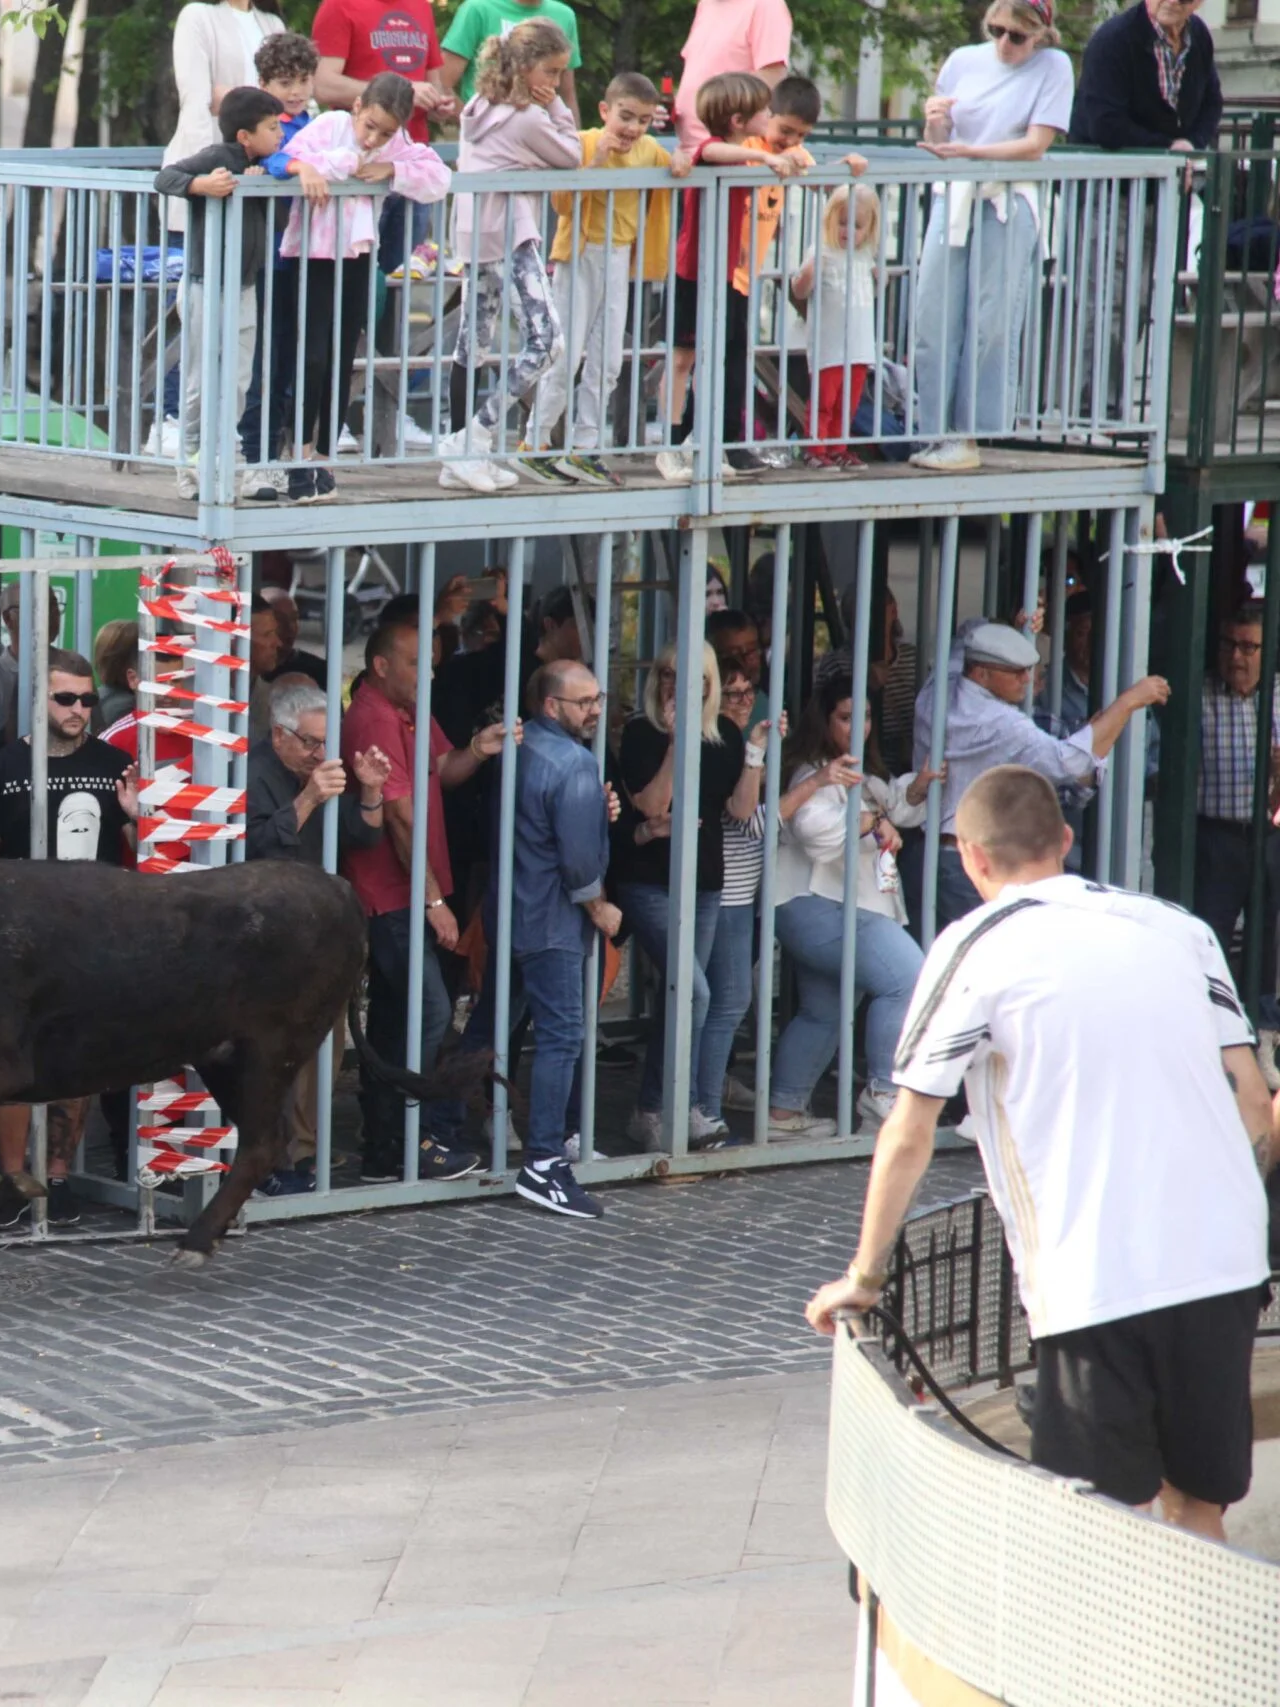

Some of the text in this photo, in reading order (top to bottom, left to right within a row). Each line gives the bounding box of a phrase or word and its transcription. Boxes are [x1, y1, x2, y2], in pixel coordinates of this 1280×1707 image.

[5, 780, 17, 788] WE
[48, 776, 113, 784] EVERYWHERE
[3, 786, 21, 795] AND
[70, 783, 115, 791] NOWHERE
